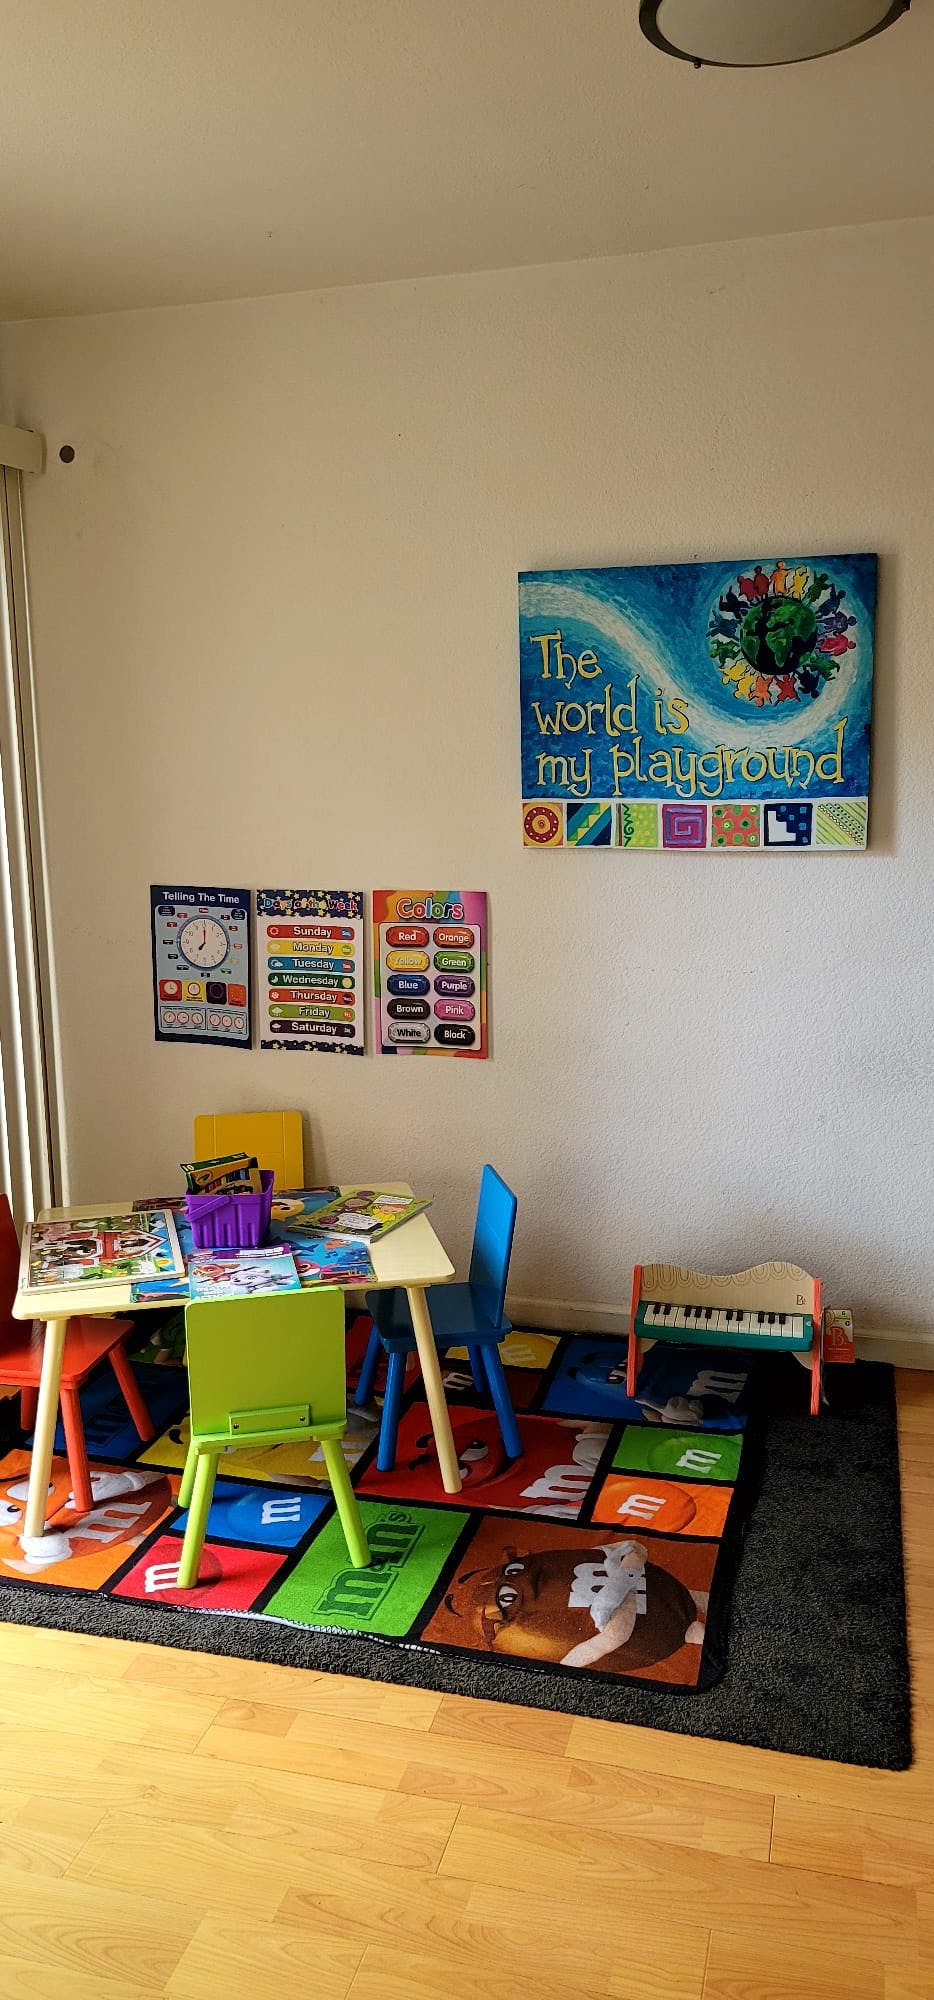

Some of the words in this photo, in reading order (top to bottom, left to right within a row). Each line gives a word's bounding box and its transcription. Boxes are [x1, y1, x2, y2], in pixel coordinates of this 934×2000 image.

[530, 630, 602, 689] The
[531, 674, 640, 736] world
[654, 688, 689, 736] is
[536, 749, 592, 797] my
[609, 717, 848, 797] playground
[162, 891, 195, 902] Telling
[198, 893, 216, 902] The
[218, 894, 240, 904] Time
[328, 900, 358, 911] Week
[396, 897, 464, 919] Colors
[293, 927, 332, 938] Sunday
[398, 931, 417, 941] Red
[438, 933, 469, 944] Orange
[292, 943, 333, 955] Monday
[292, 959, 334, 971] Tuesday
[394, 956, 422, 966] Yellow
[442, 957, 467, 967] Green
[282, 975, 339, 987] Wednesday
[398, 980, 419, 990] Blue
[441, 981, 468, 992] Purple
[290, 991, 338, 1003] Thursday
[298, 1007, 330, 1018] Friday
[397, 1004, 424, 1013] Brown
[445, 1006, 464, 1015] Pink
[291, 1022, 337, 1035] Saturday
[397, 1028, 422, 1037] White
[444, 1030, 466, 1040] Black
[182, 1164, 194, 1172] 10
[675, 1448, 722, 1474] m
[261, 1497, 300, 1525] m
[617, 1493, 667, 1520] m
